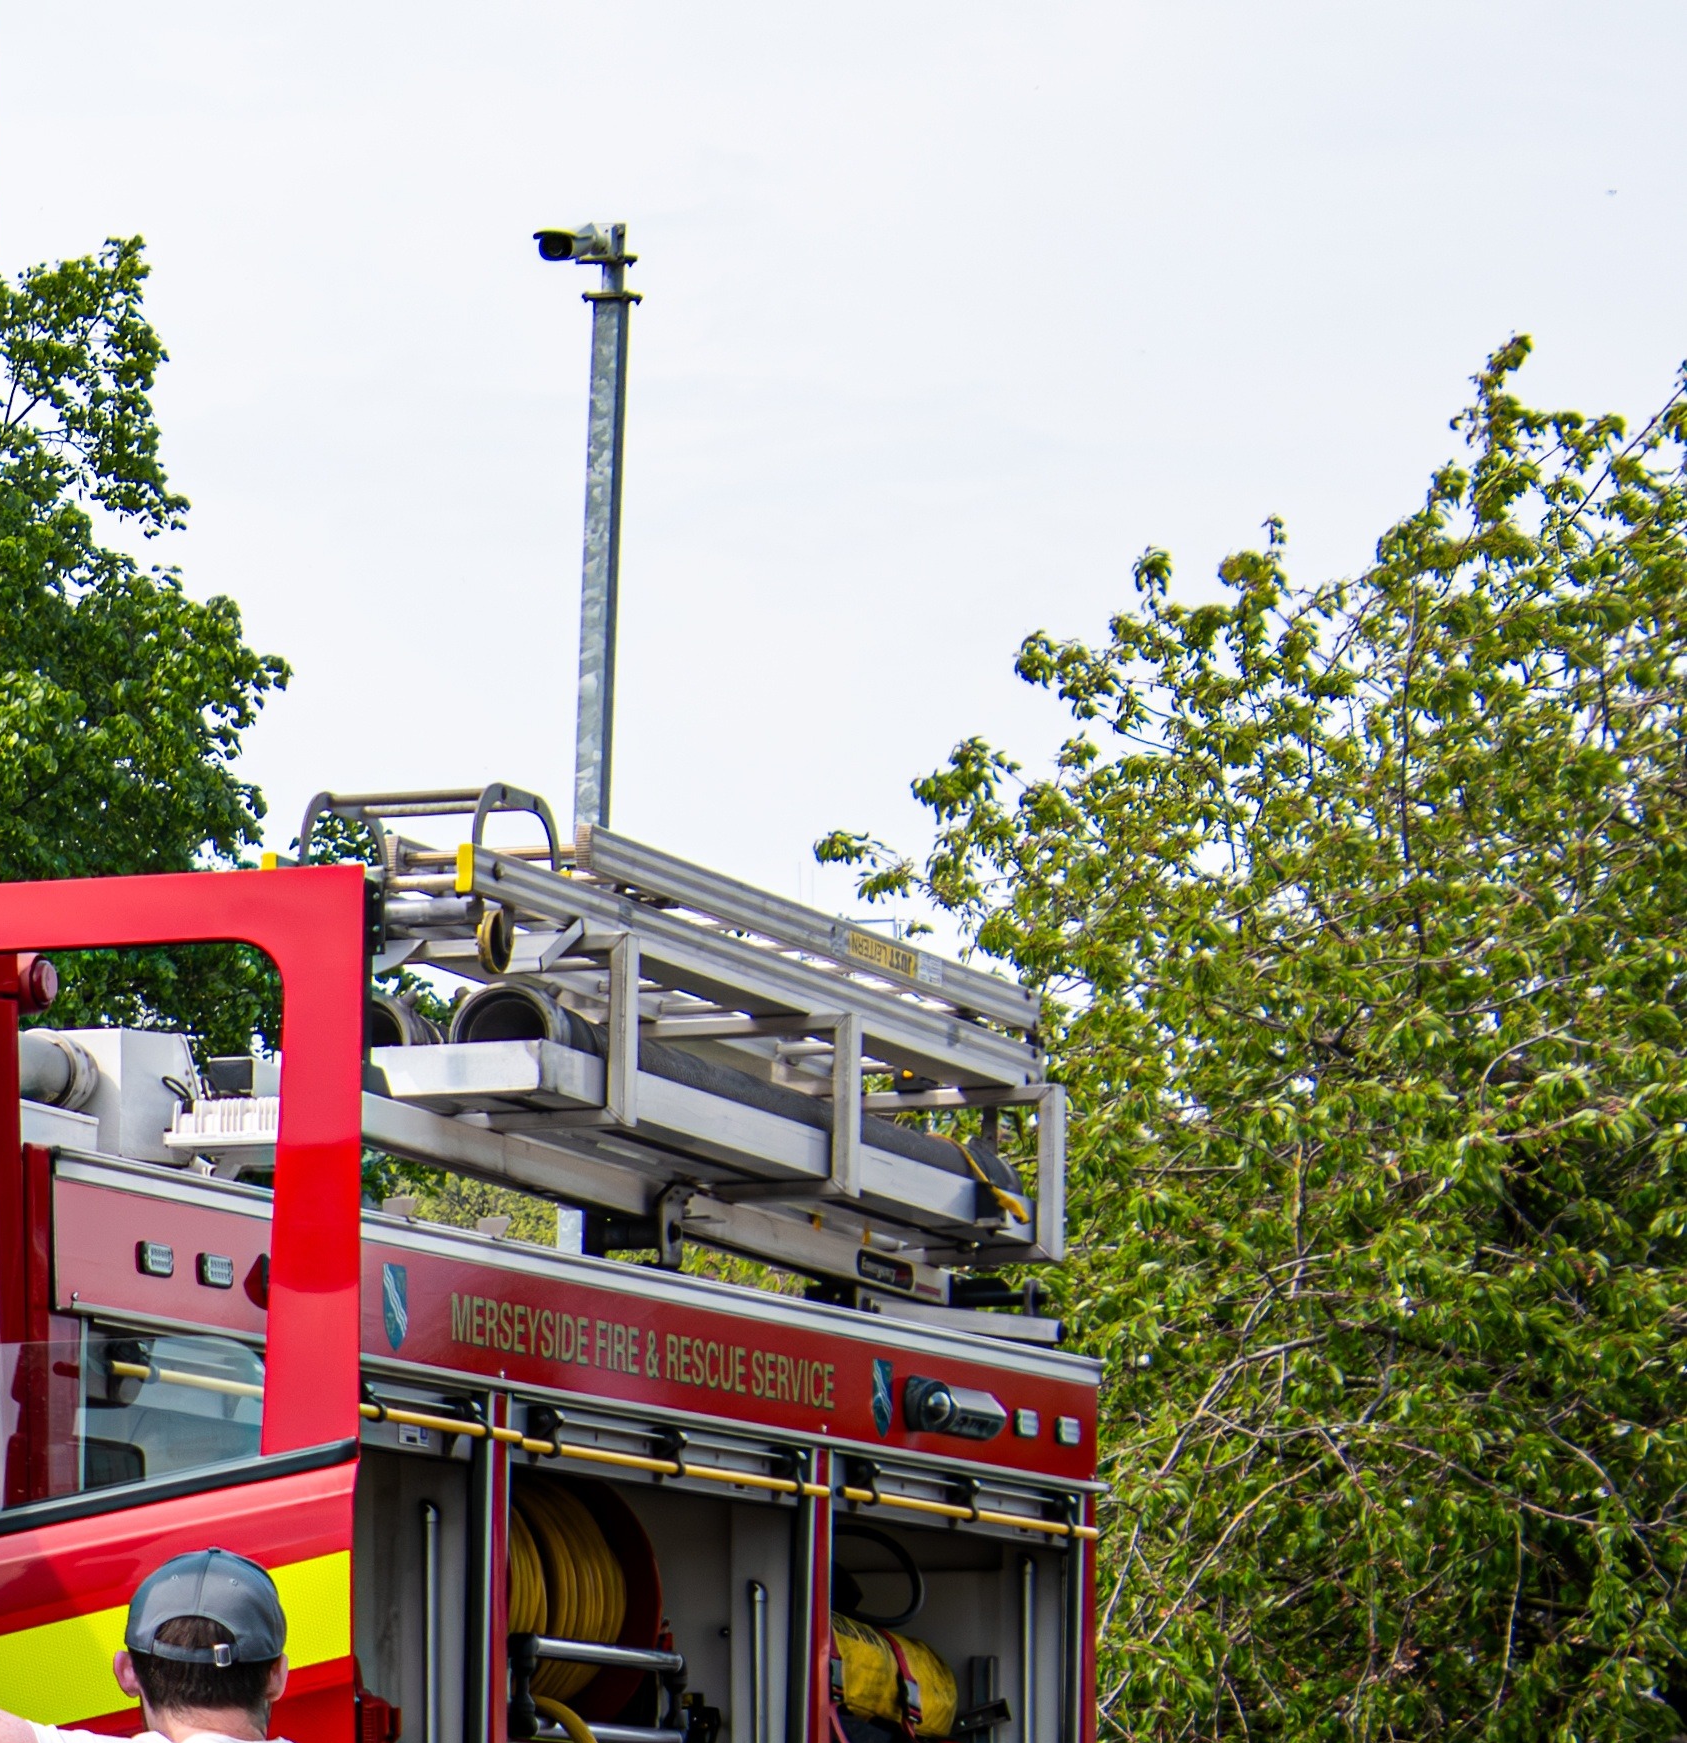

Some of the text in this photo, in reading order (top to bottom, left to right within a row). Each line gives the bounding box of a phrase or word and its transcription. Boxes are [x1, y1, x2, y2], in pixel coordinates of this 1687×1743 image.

[450, 1292, 835, 1410] MERSEYSIDE FIRE & RESCUE SERVICE
